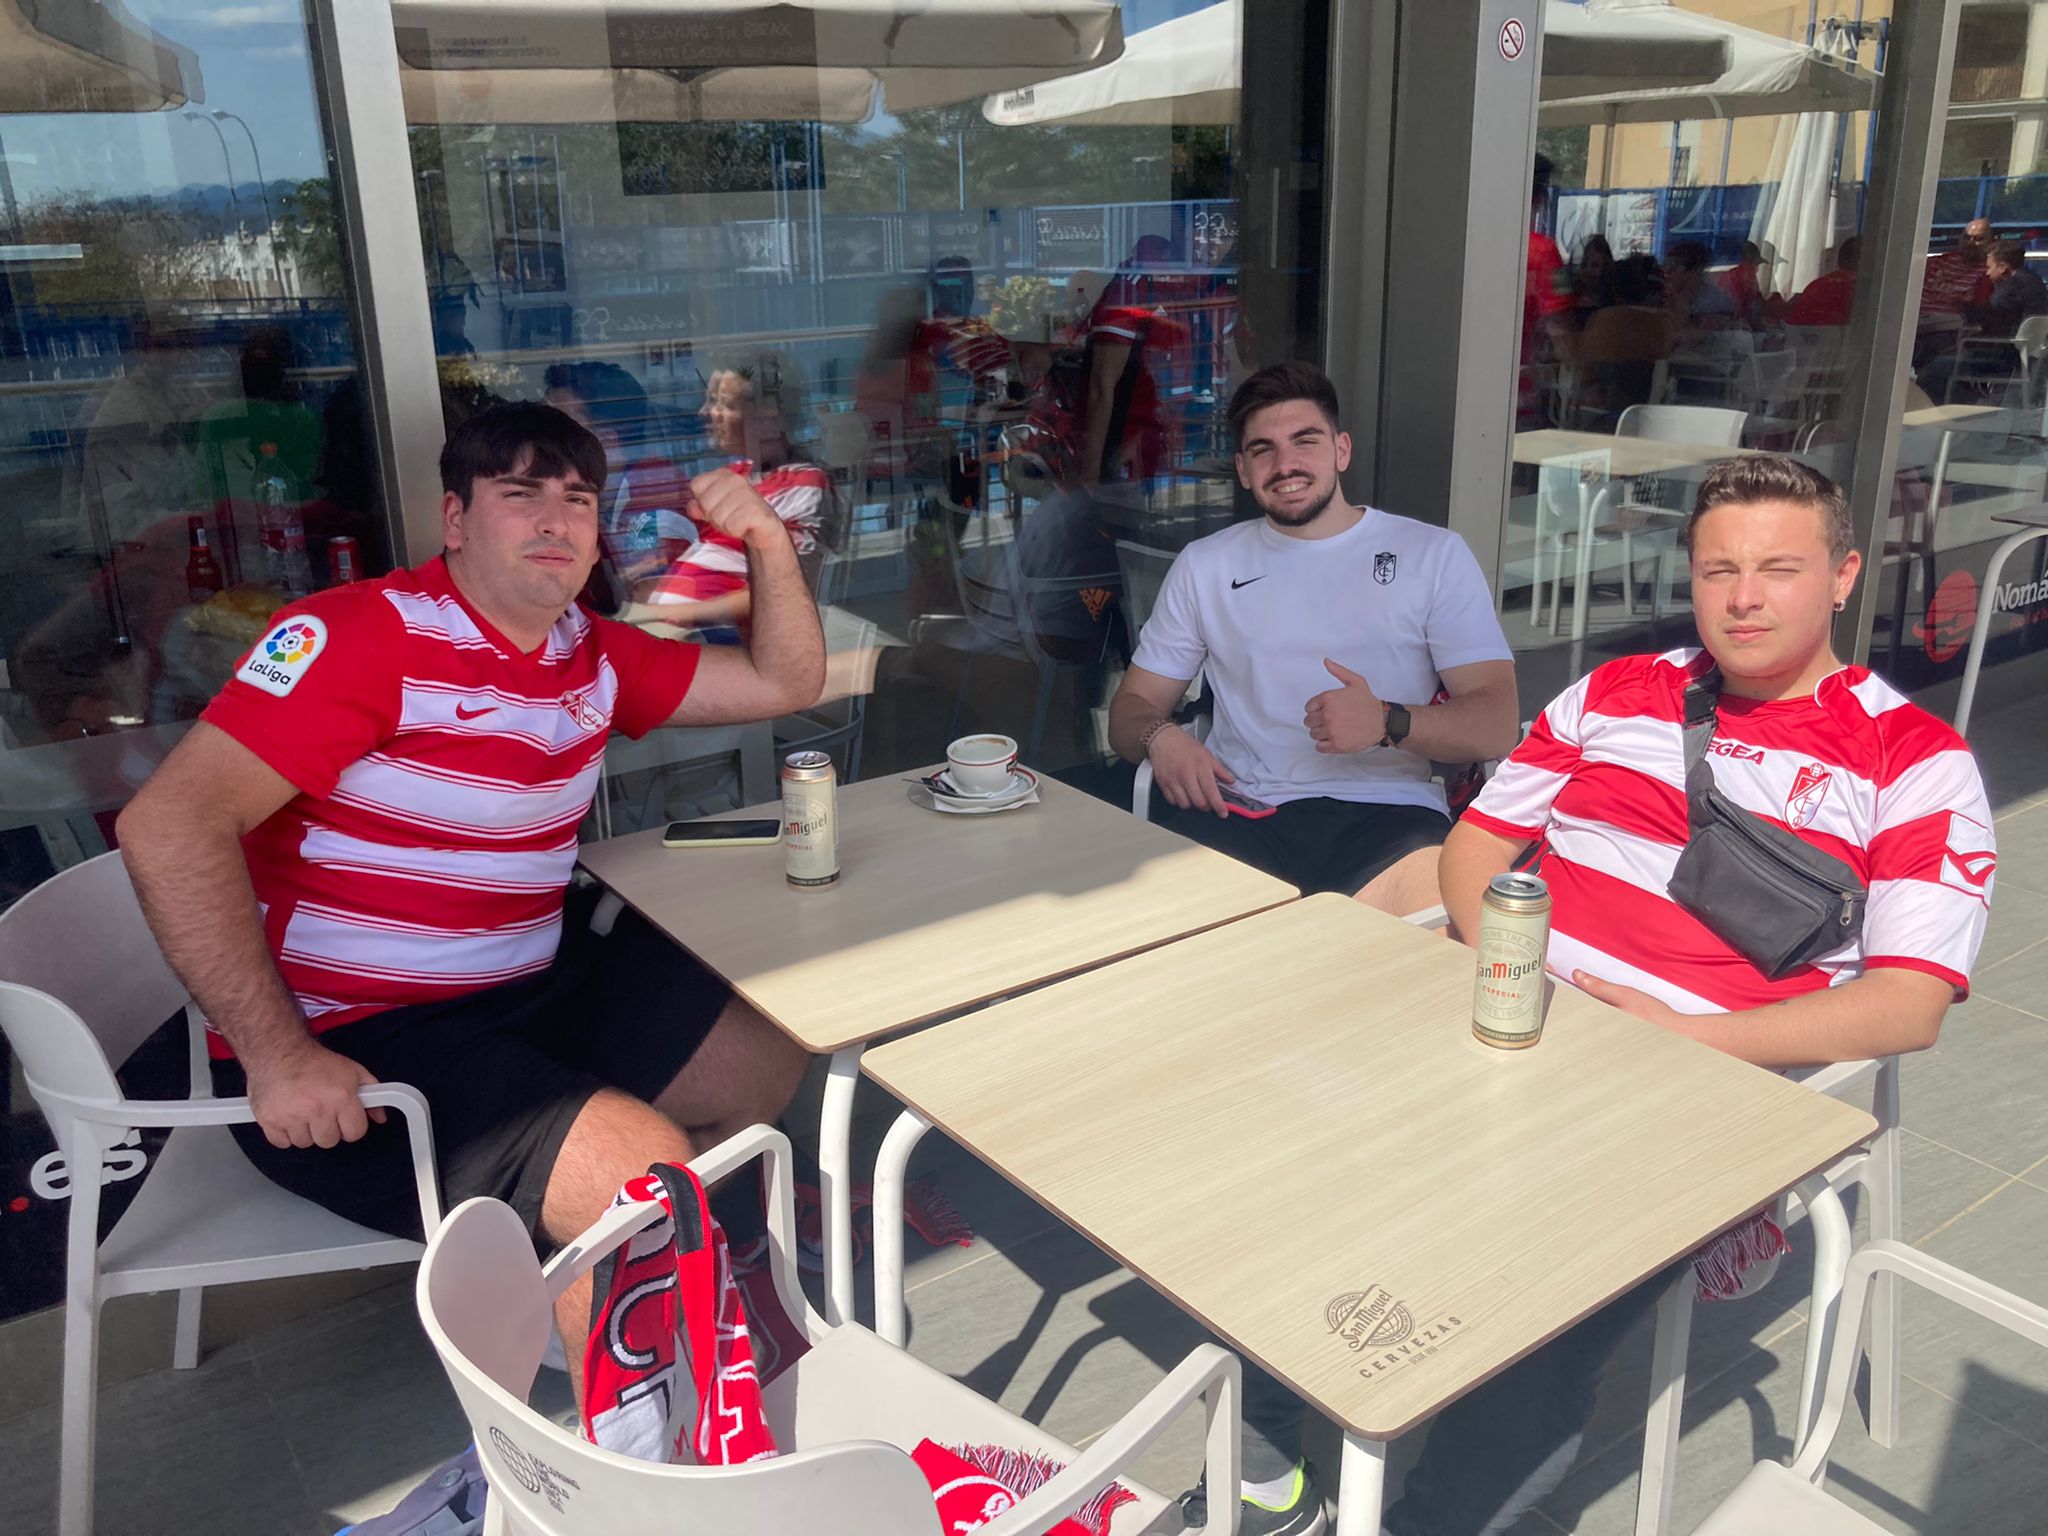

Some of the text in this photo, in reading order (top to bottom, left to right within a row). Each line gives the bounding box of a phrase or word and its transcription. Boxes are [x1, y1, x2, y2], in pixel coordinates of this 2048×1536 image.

[248, 660, 291, 685] LaLiga
[1708, 740, 1765, 766] EGEA
[1483, 985, 1521, 999] ESPECIAL
[1359, 1316, 1462, 1379] CERVEZAS
